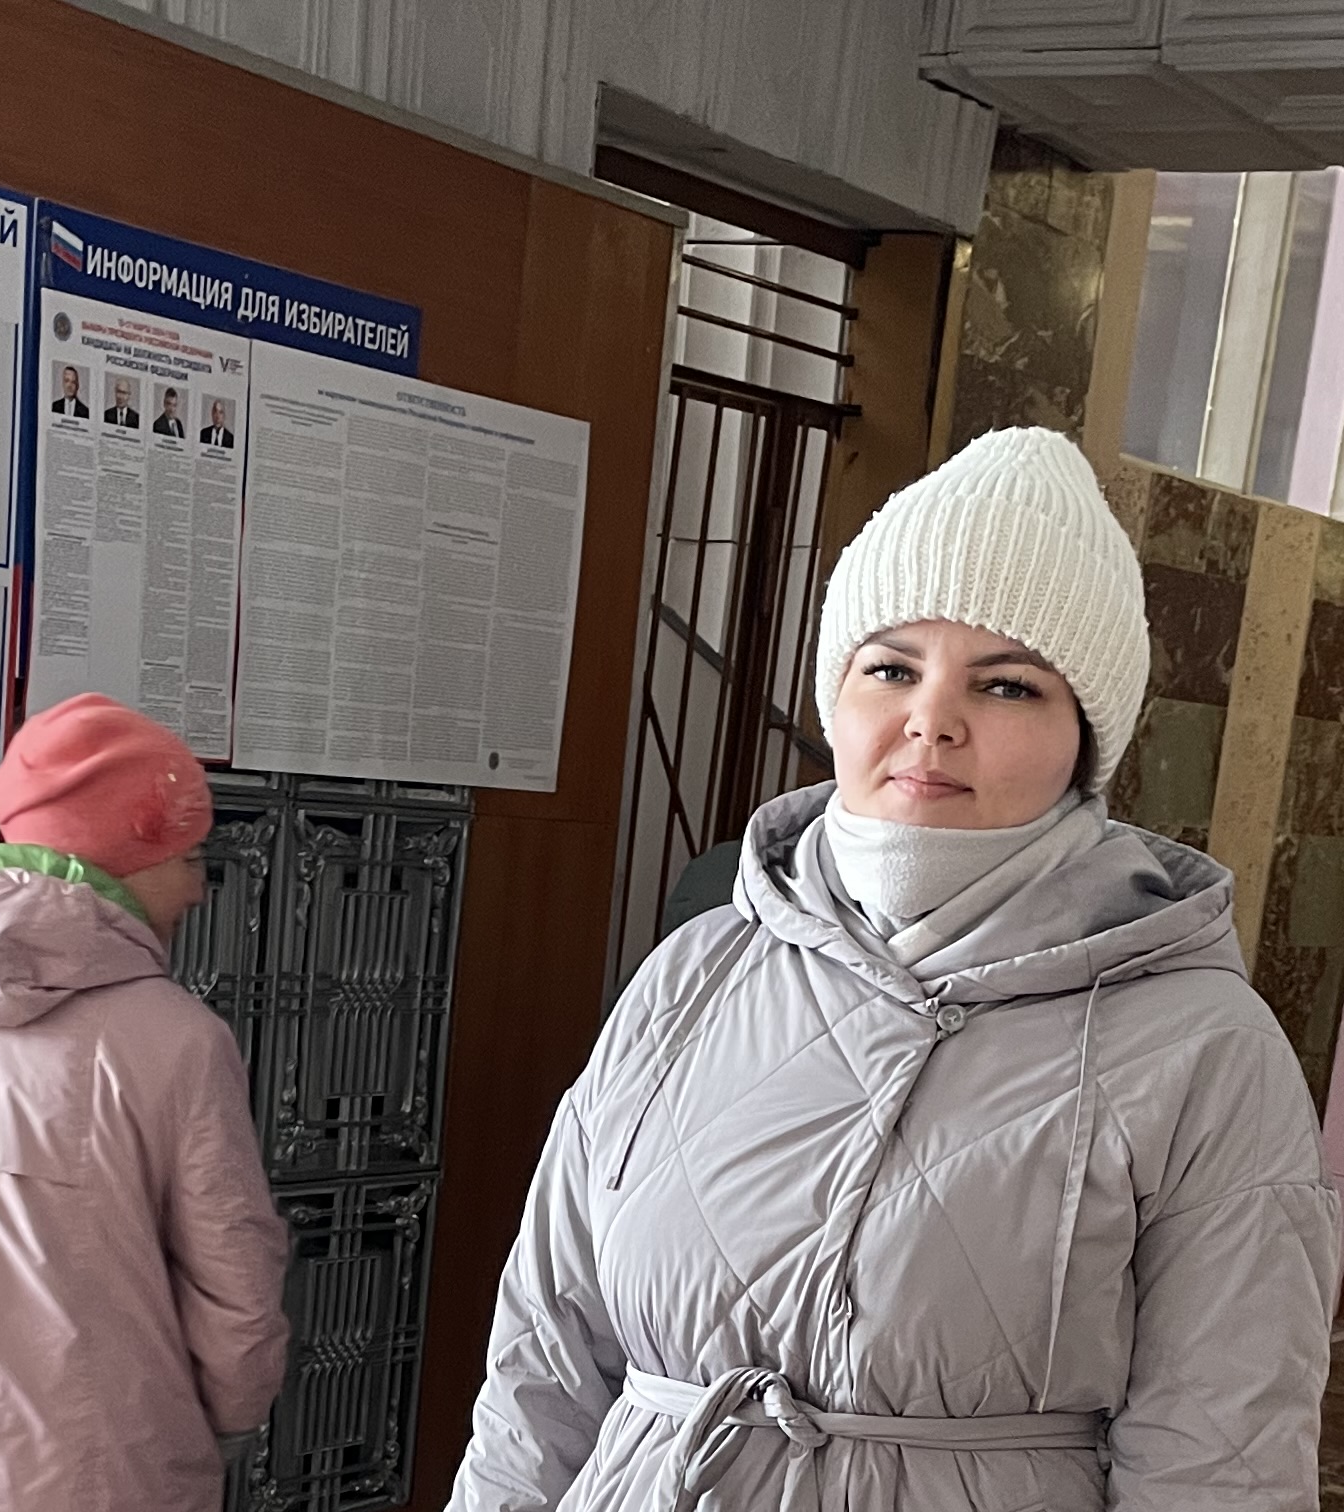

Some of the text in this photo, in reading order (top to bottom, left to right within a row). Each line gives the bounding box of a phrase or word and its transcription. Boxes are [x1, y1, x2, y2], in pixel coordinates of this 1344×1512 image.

[86, 244, 233, 311] ИНФОРМАЦИЯ
[237, 286, 280, 323] ДЛЯ
[284, 297, 410, 359] ИЗБИРАТЕЛЕЙ
